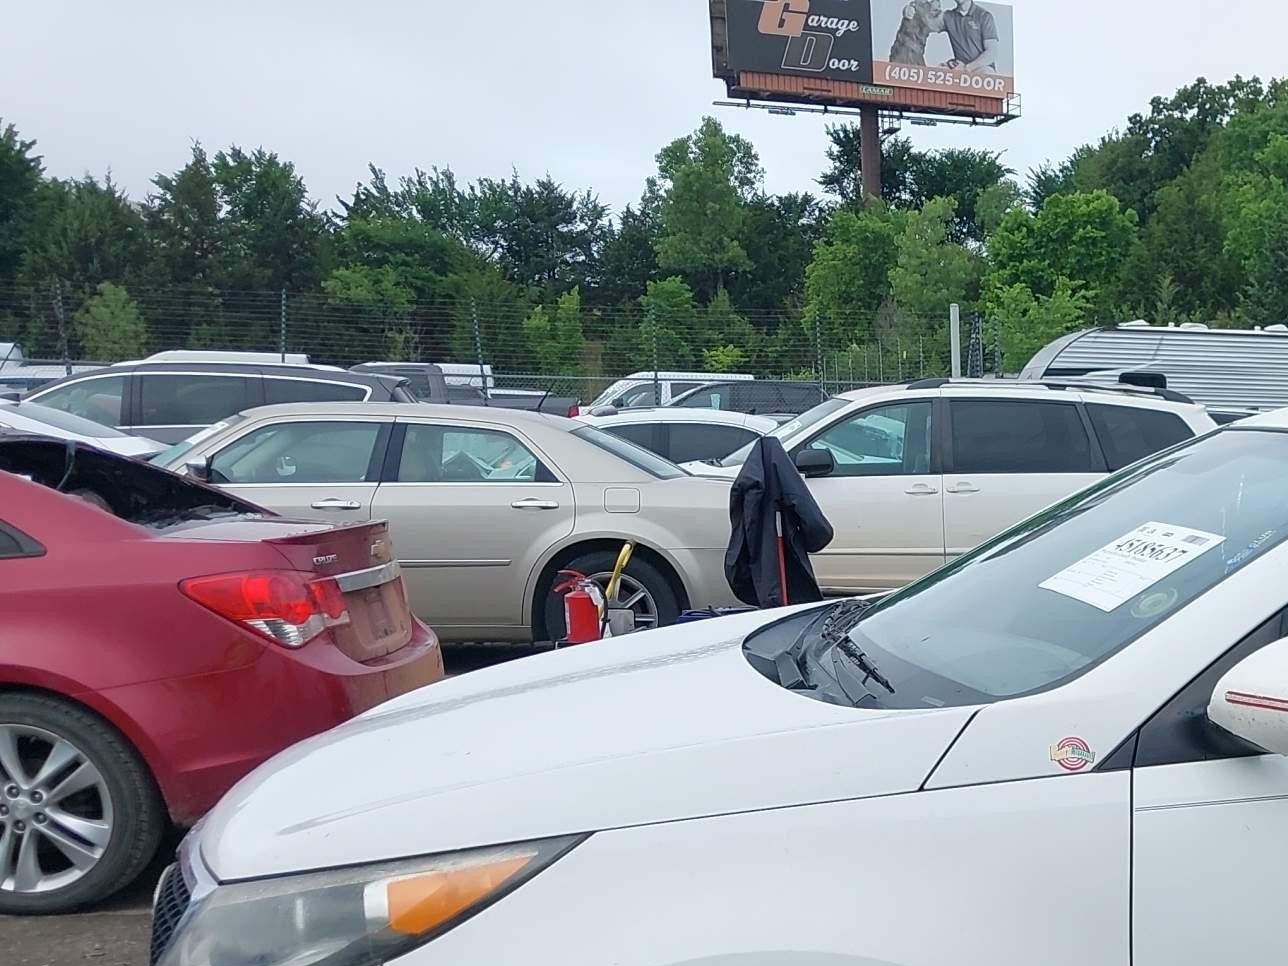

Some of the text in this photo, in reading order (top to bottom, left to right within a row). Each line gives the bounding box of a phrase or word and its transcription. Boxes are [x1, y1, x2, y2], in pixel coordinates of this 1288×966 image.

[758, 0, 860, 37] Garage
[781, 30, 860, 72] Door
[885, 65, 1005, 92] (405) 525-DOOR
[1115, 538, 1189, 563] 45185637
